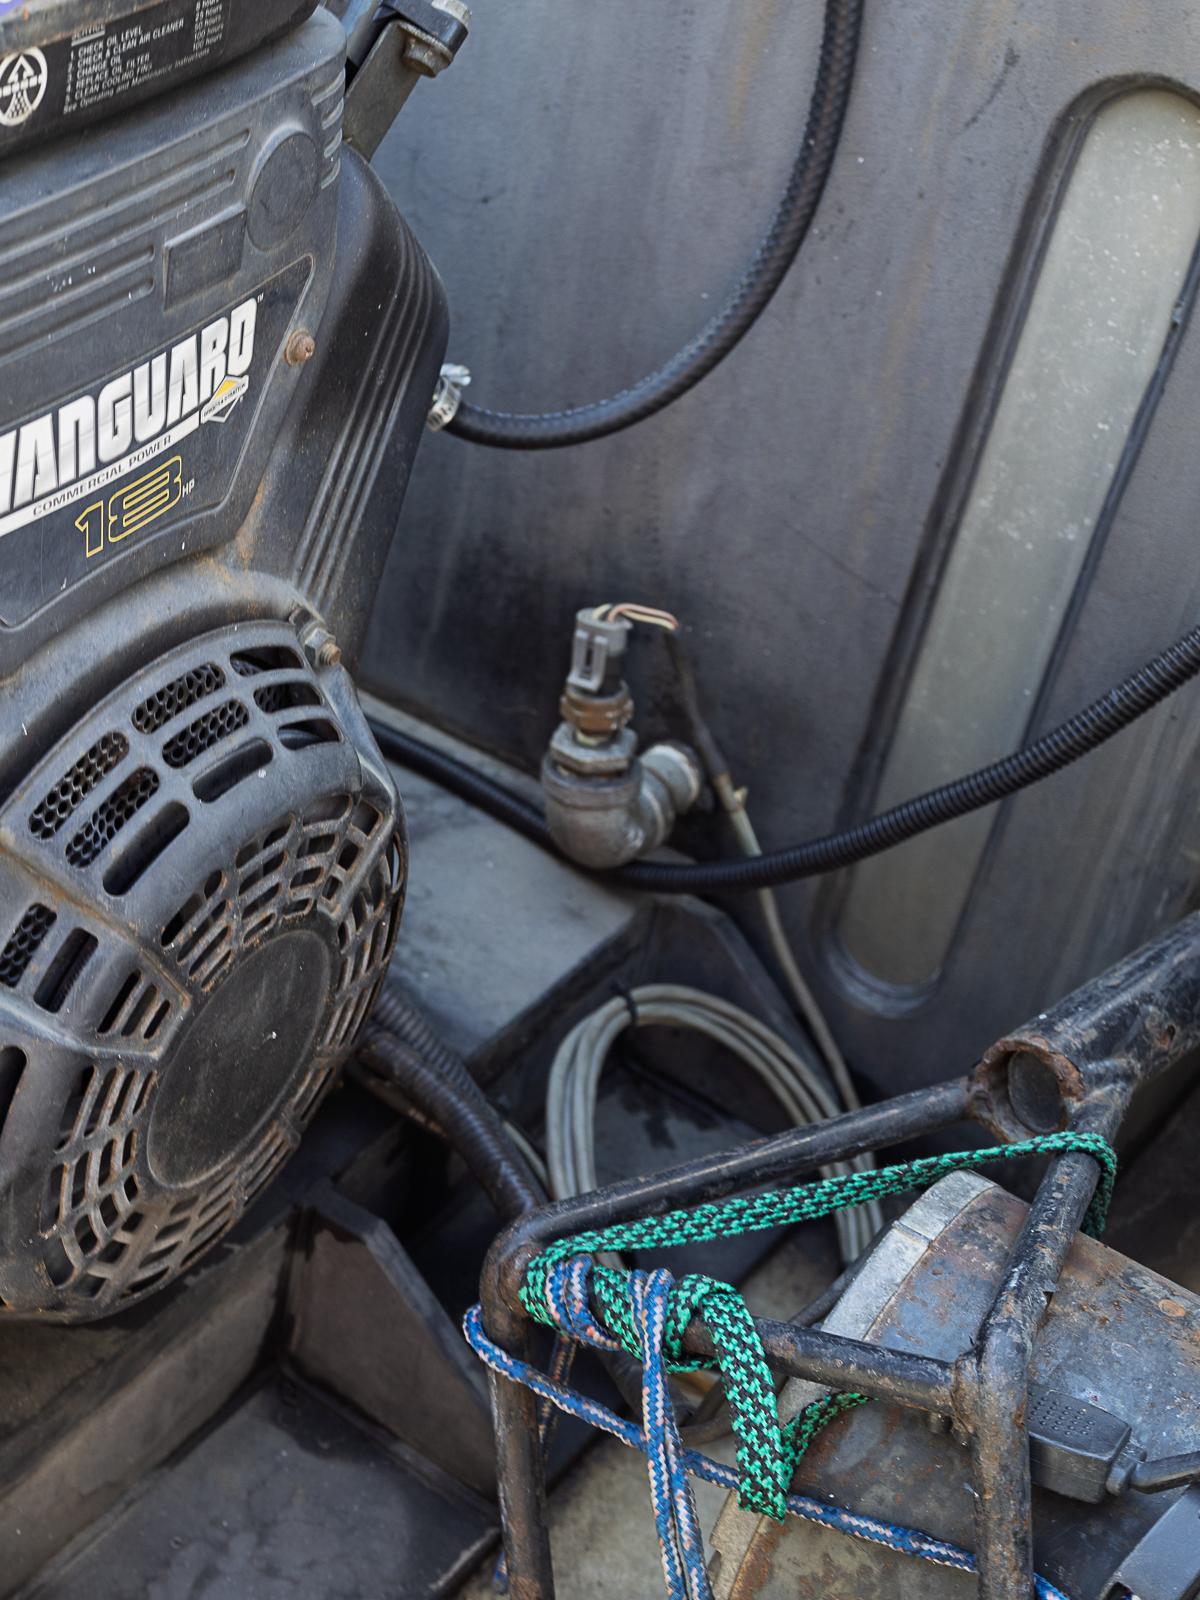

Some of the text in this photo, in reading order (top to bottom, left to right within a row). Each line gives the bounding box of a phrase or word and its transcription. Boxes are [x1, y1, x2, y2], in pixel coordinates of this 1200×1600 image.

[77, 52, 103, 69] CHECK
[113, 38, 137, 55] CLEAN
[138, 31, 151, 45] AIR
[152, 18, 184, 40] CLEANER
[78, 40, 103, 59] CHECK
[106, 34, 118, 46] OIL
[121, 25, 143, 41] LEVEL
[63, 103, 77, 115] See
[79, 87, 114, 109] Operating
[116, 81, 129, 94] and
[131, 64, 172, 88] Maintenance
[74, 82, 100, 101] CLEAN
[102, 70, 134, 89] COOLING
[76, 60, 108, 80] CHANGE
[110, 55, 121, 67] OIL
[76, 69, 109, 89] REPLACE
[112, 65, 122, 77] OIL
[126, 52, 150, 70] FILTER
[32, 434, 172, 518] COMMERCIAL POWER
[74, 455, 195, 558] 18 HP
